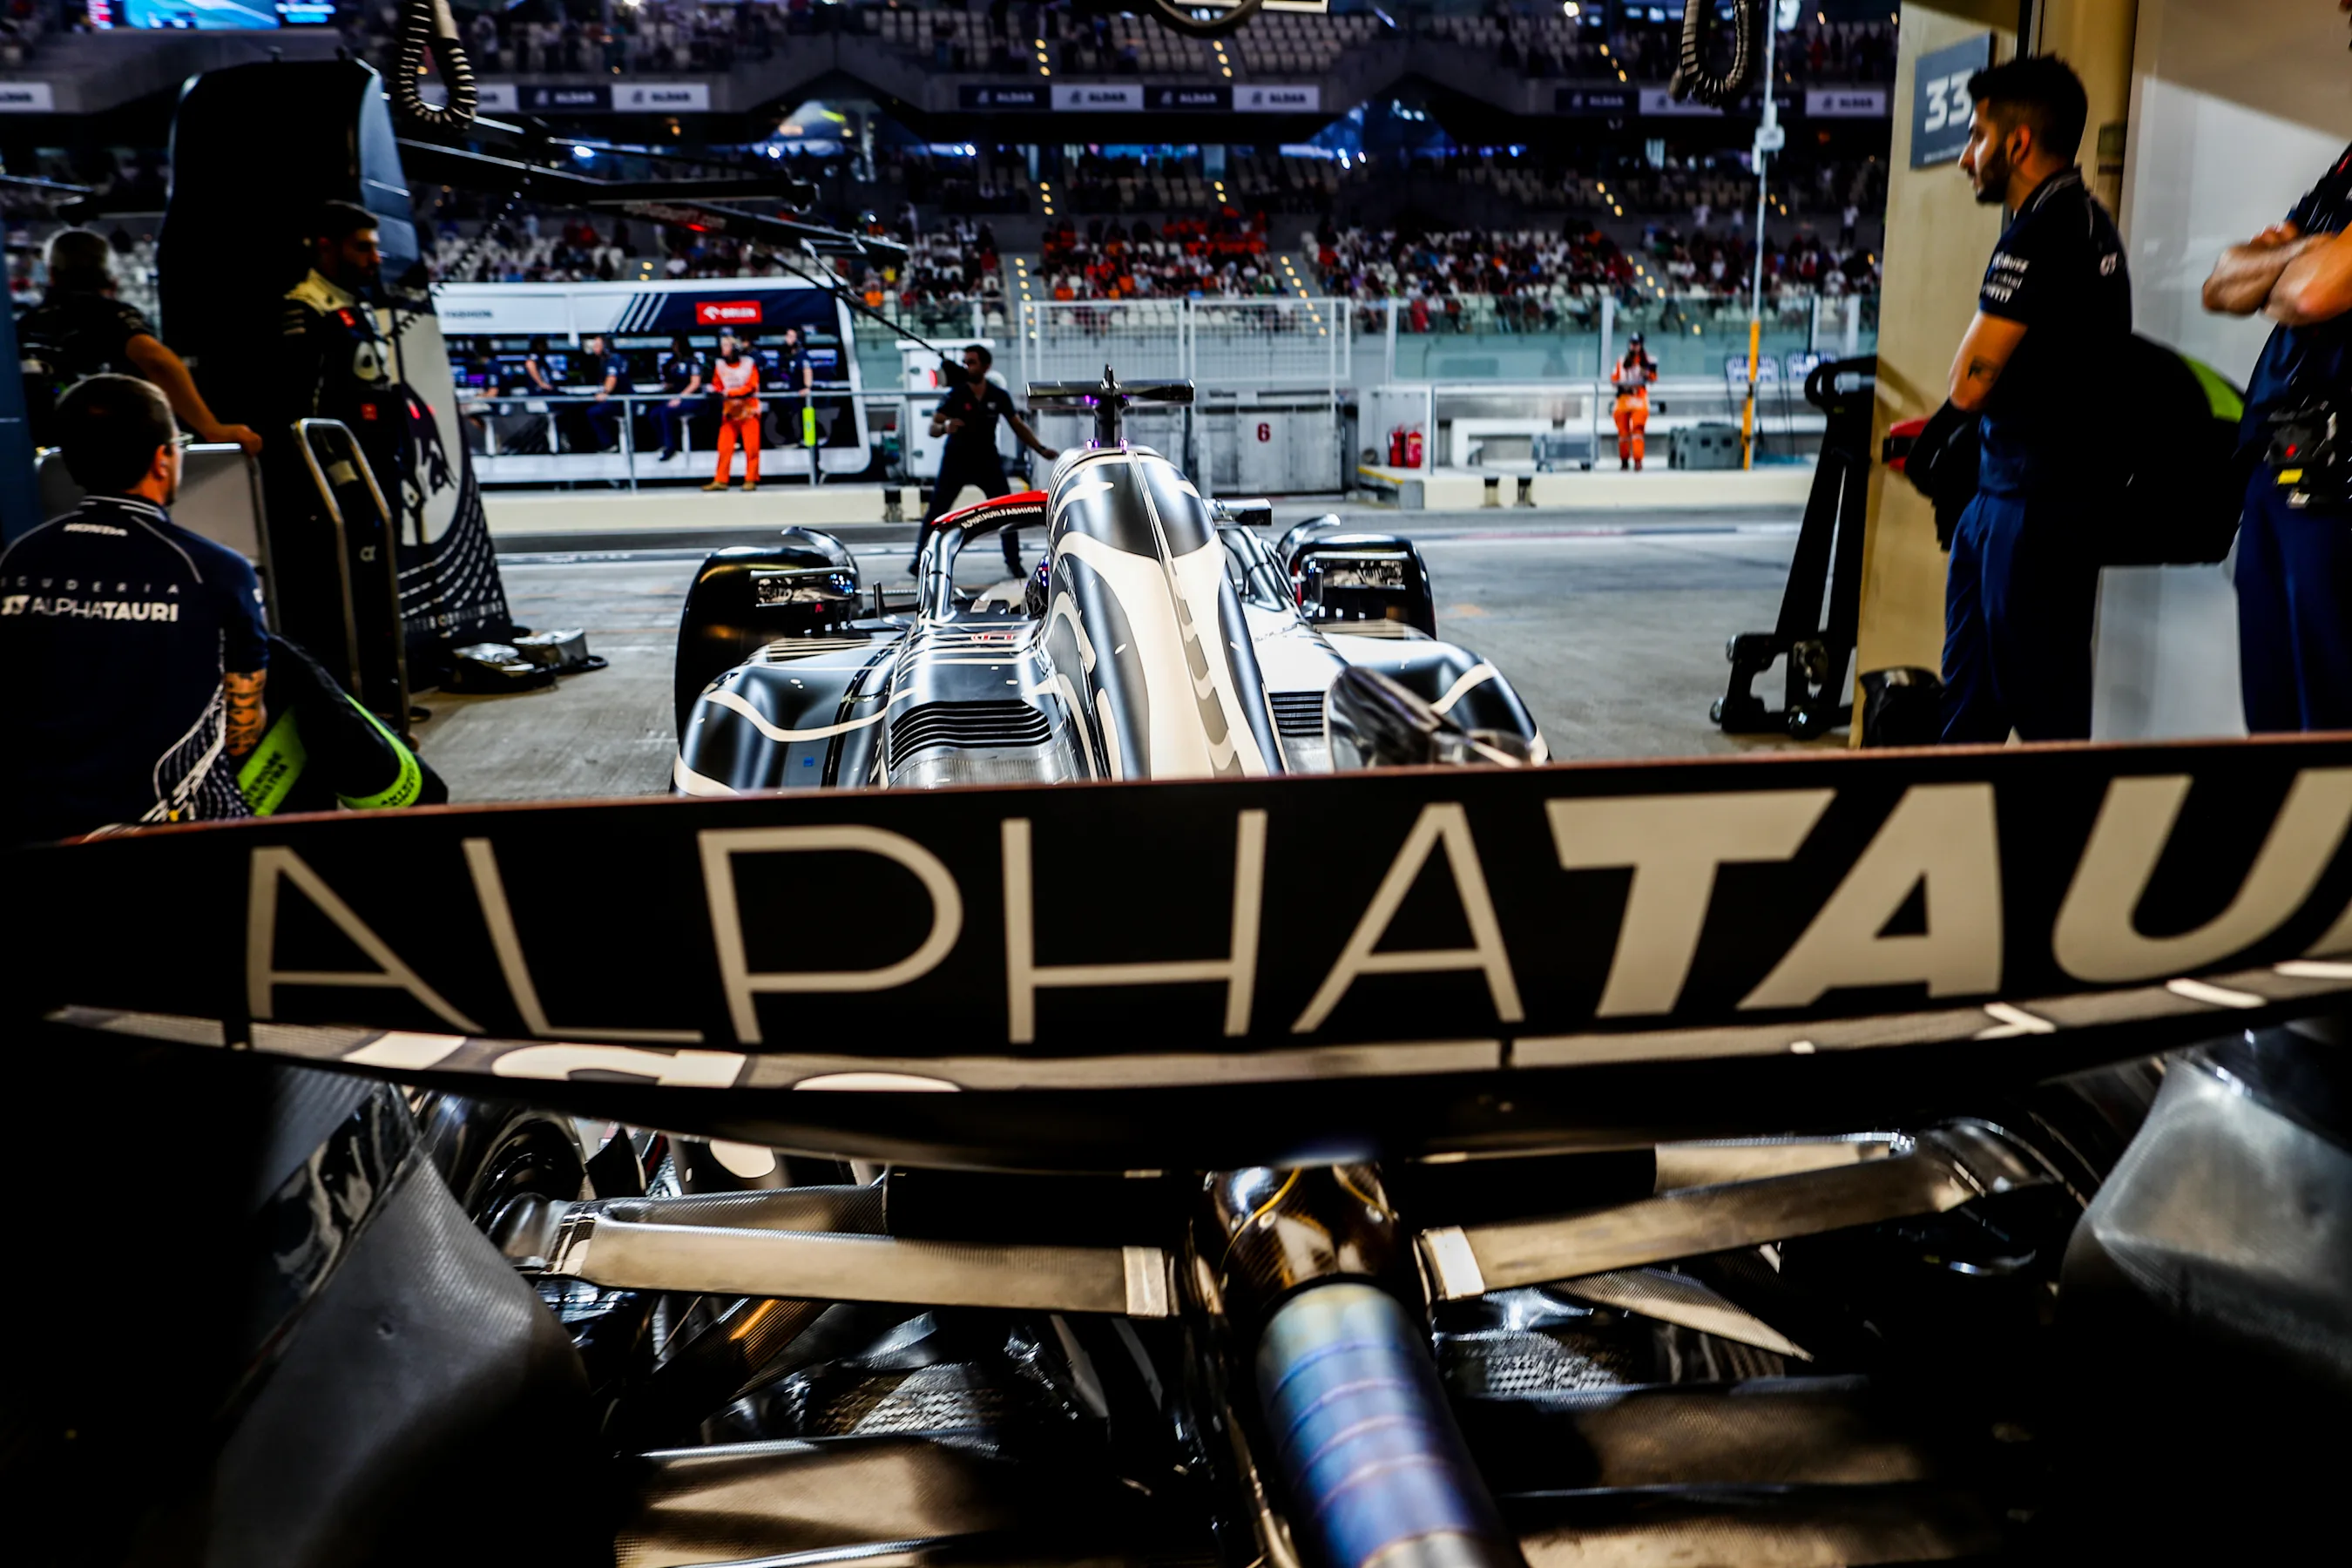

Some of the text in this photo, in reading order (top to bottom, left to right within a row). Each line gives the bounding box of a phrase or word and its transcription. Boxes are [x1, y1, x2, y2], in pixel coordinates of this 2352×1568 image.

[1924, 68, 1974, 134] 33
[1257, 422, 1270, 443] 6
[64, 523, 129, 537] HONDA
[30, 596, 179, 622] ALPHATAURI
